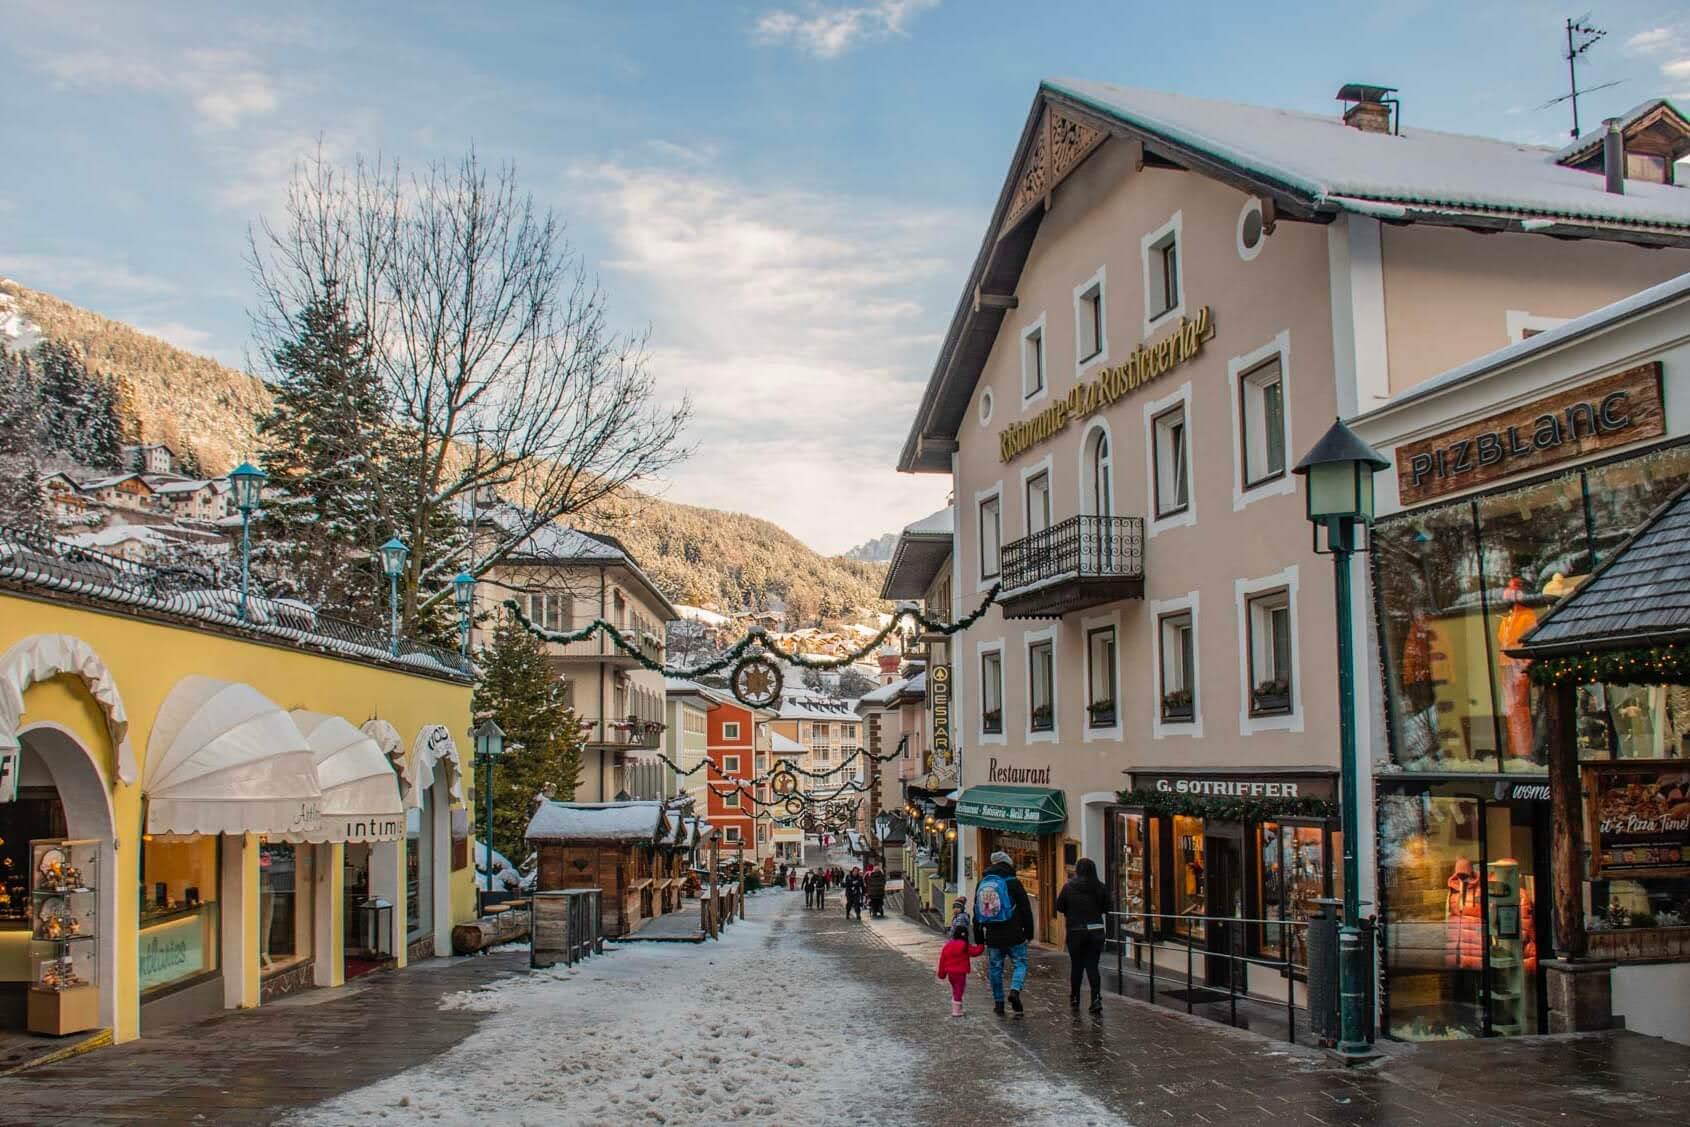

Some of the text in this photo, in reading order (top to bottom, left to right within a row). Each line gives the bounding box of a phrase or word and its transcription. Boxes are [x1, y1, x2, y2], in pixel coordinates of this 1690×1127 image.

[934, 683, 949, 748] DESPAR
[988, 757, 1051, 785] Restaurant
[1156, 779, 1298, 798] G. SOTRIFFER
[1659, 813, 1690, 832] Time!
